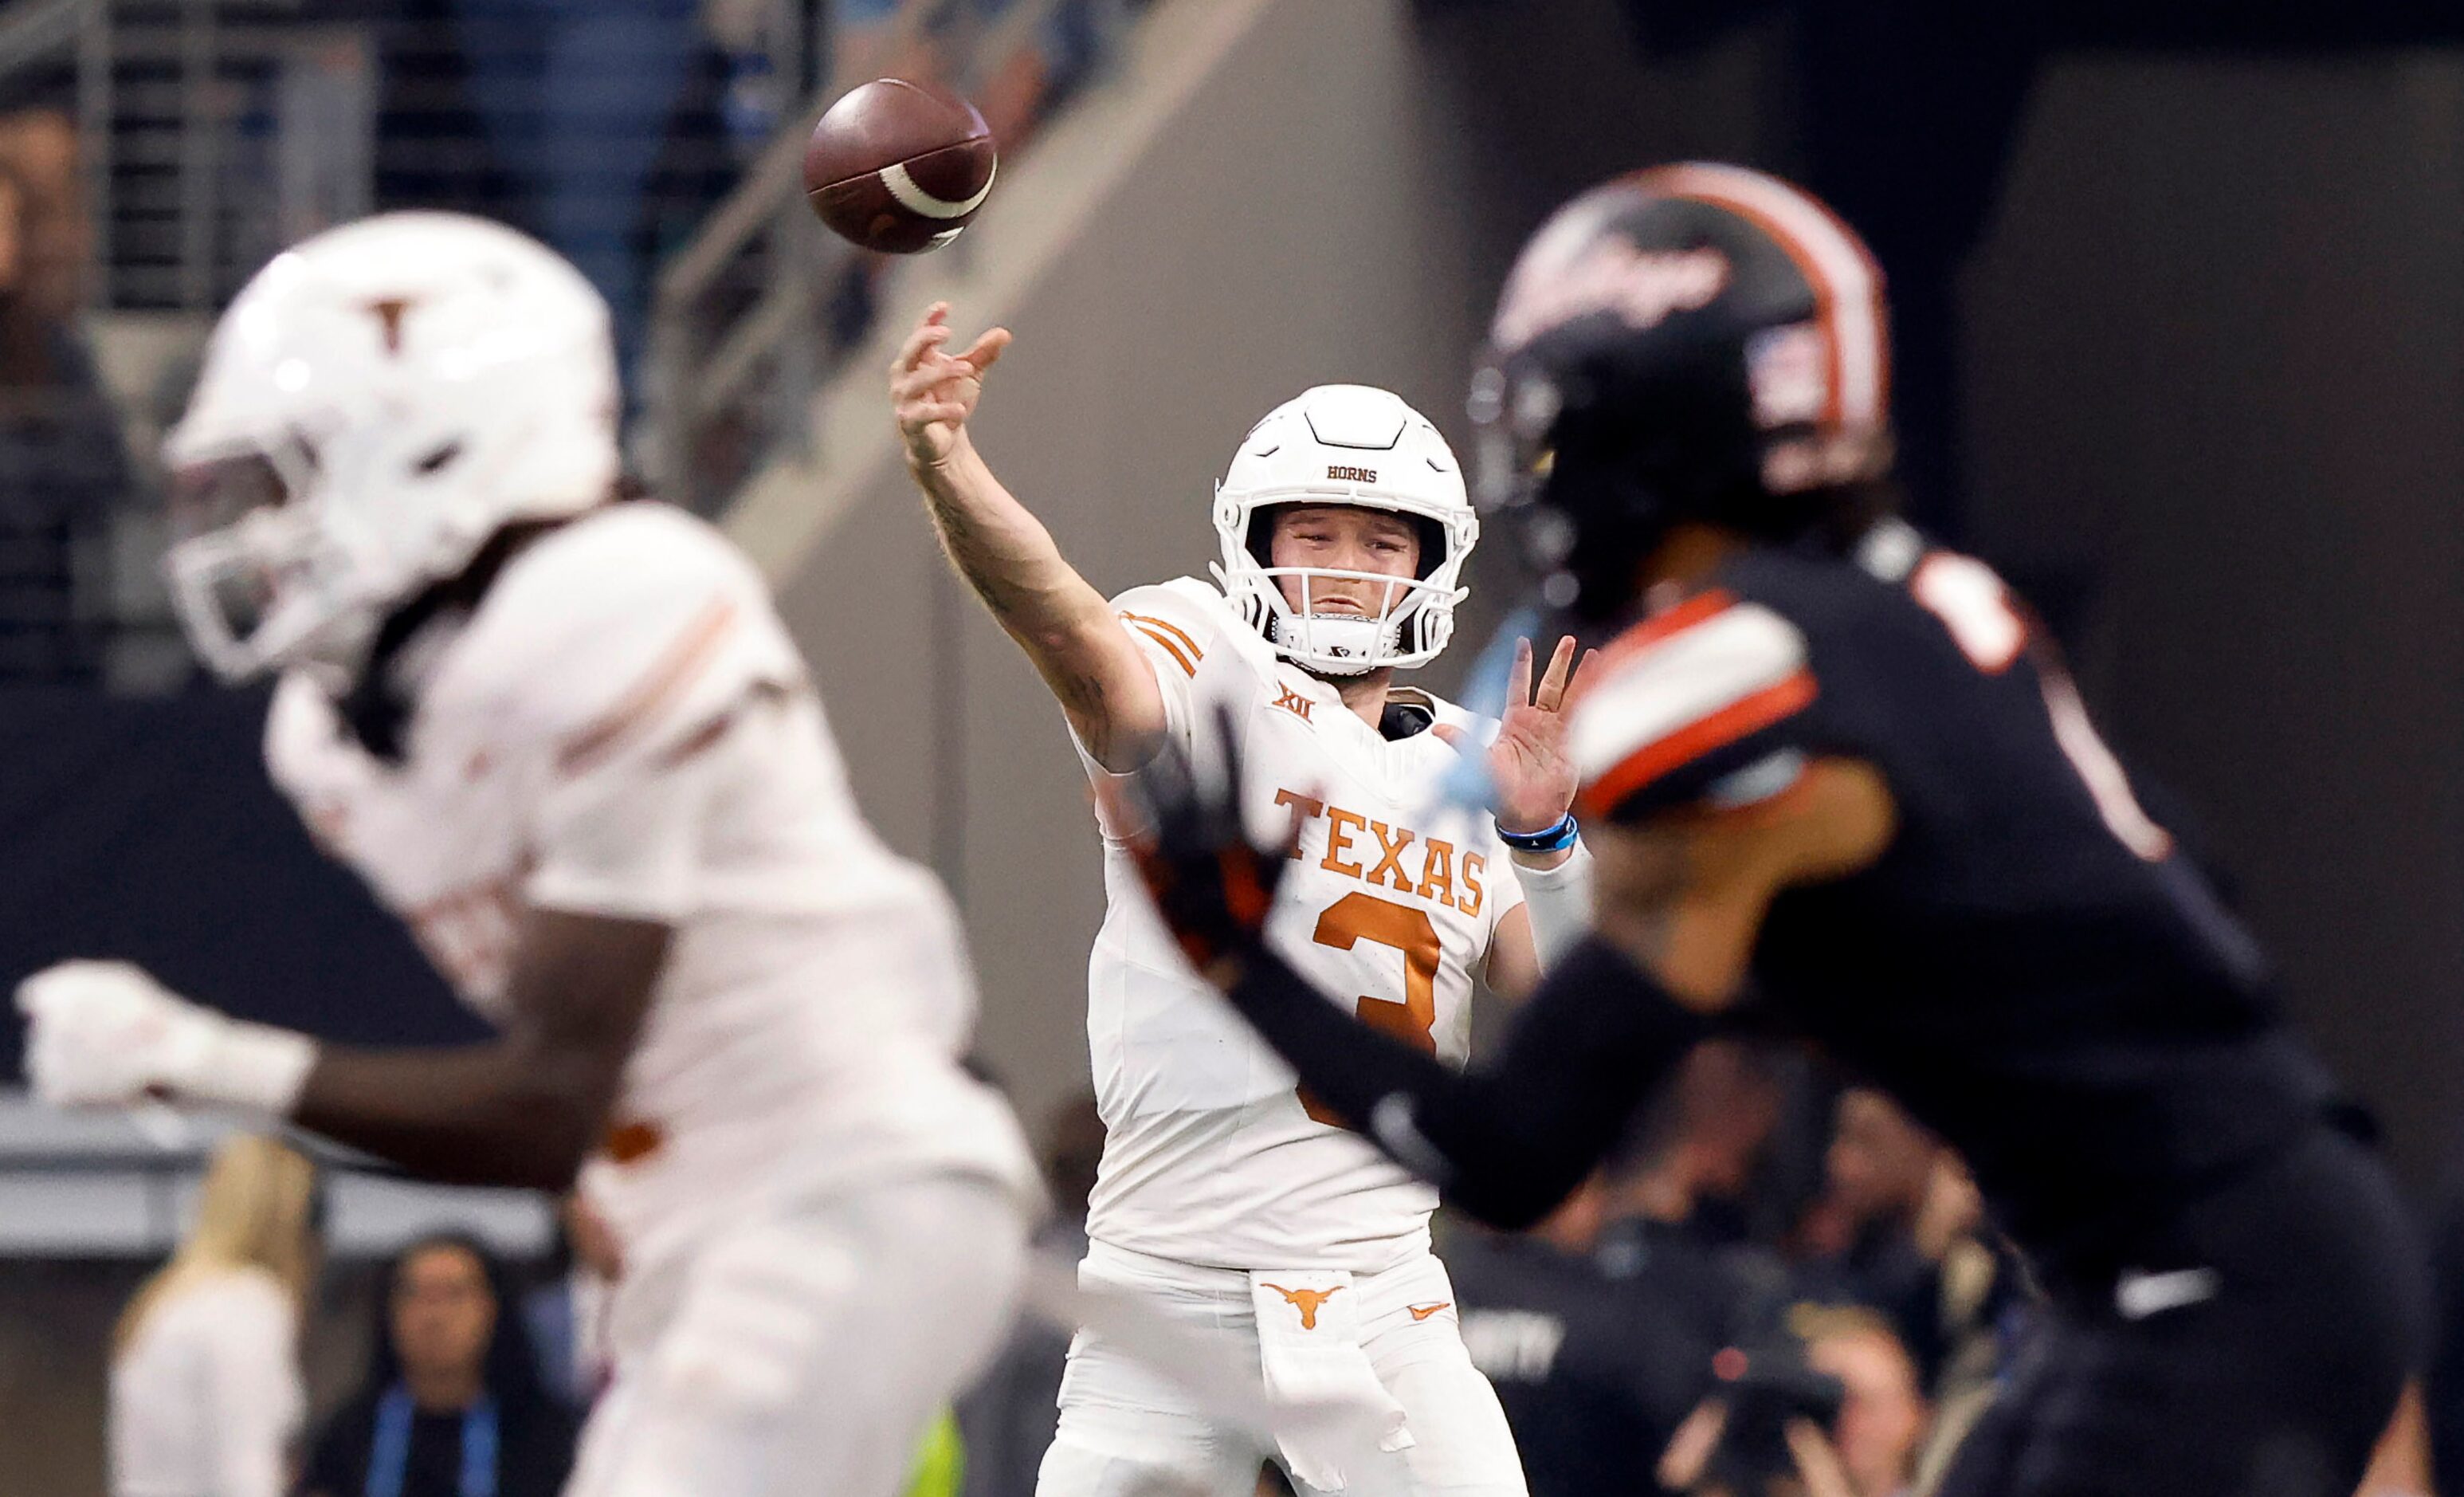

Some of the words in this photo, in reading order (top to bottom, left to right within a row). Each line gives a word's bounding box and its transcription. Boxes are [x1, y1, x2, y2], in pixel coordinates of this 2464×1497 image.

[1327, 466, 1377, 483] HORNS
[1271, 678, 1316, 725] XII
[1274, 788, 1485, 917] TEXAS
